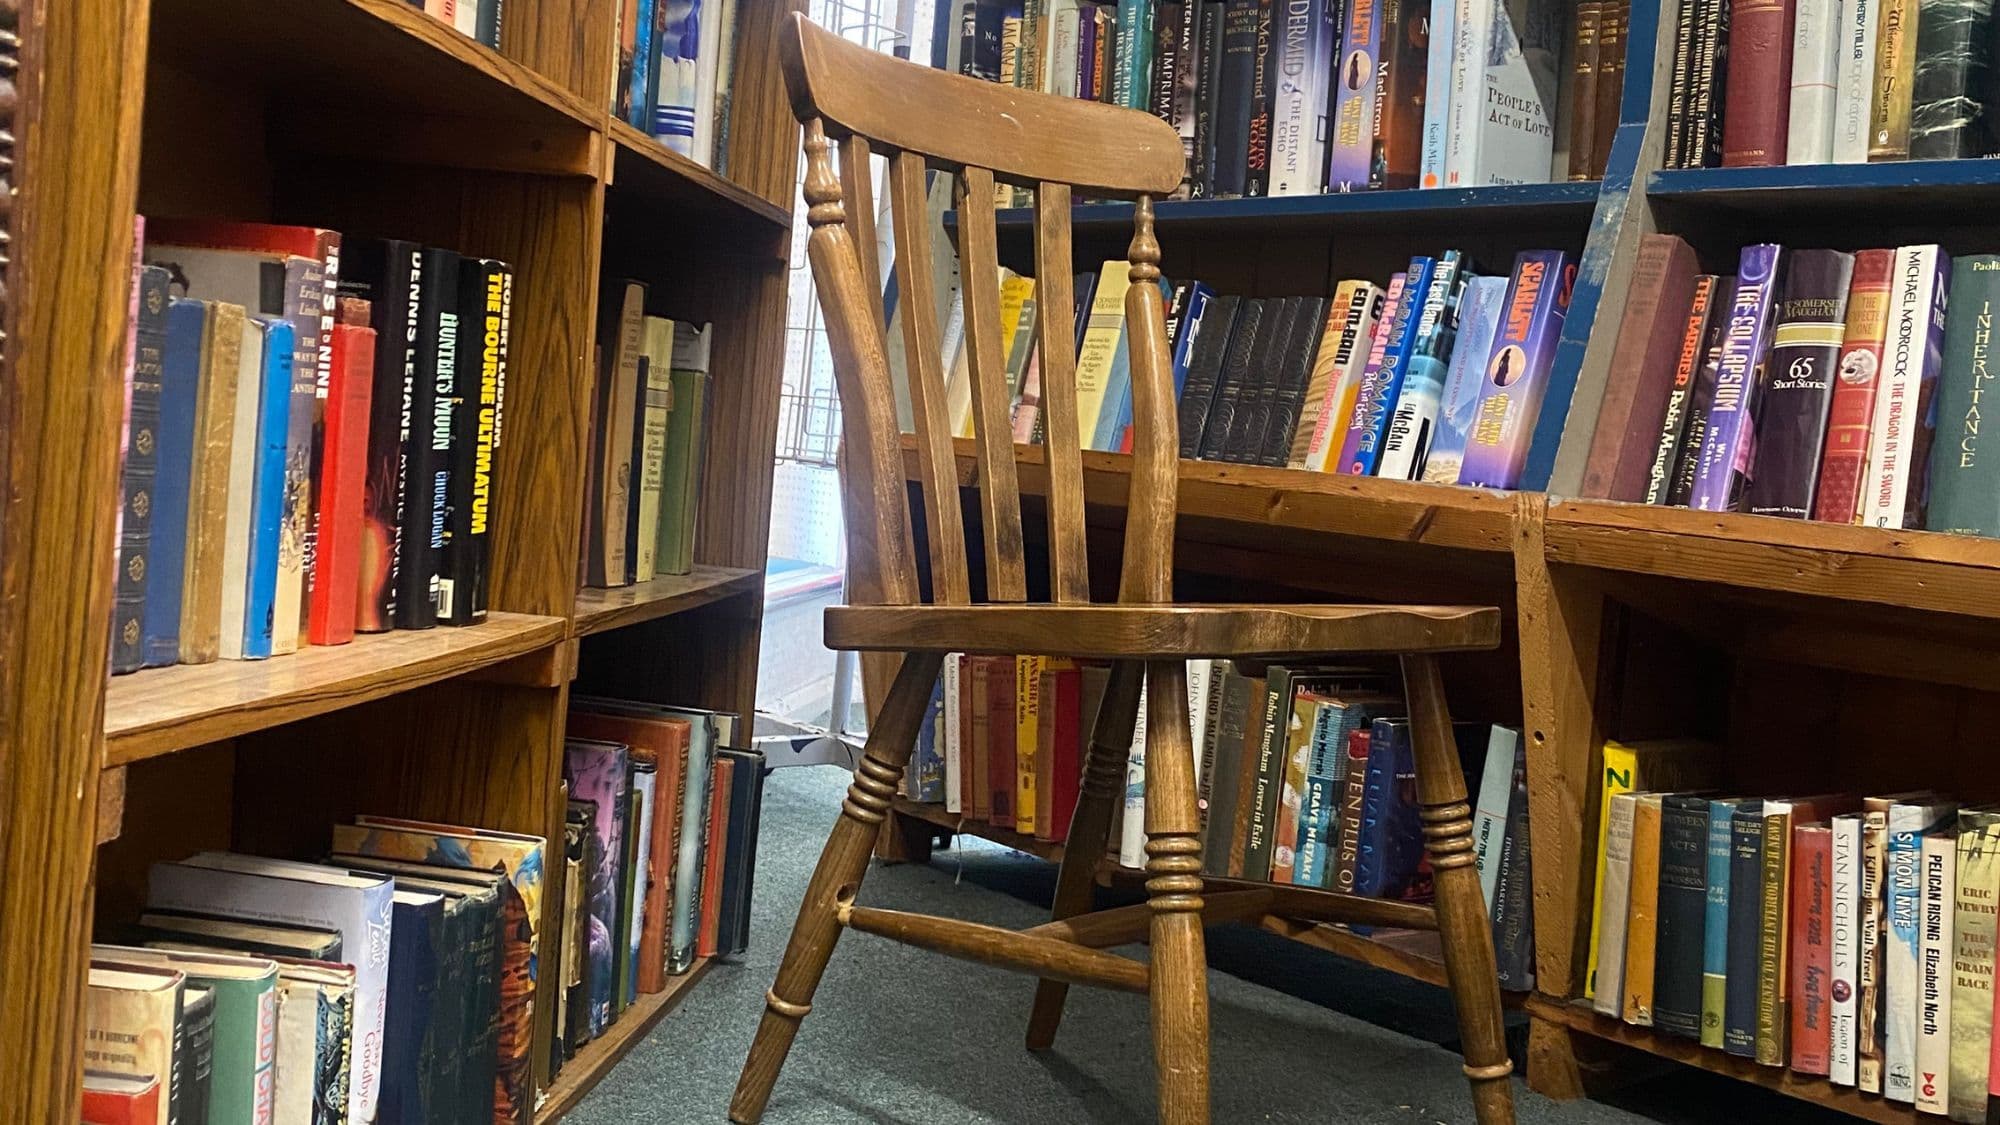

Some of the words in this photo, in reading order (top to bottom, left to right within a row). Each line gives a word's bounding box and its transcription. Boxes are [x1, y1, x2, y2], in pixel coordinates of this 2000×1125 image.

[1127, 5, 1137, 26] THE
[1856, 0, 1867, 27] HENRY
[1115, 32, 1125, 58] IRIS
[1122, 28, 1135, 72] MESSAGE
[1182, 27, 1191, 51] MAY
[1700, 23, 1718, 91] MARLBOROUGH
[1853, 28, 1864, 60] MILLER
[1883, 9, 1901, 70] Whispering
[1255, 19, 1271, 99] McDermid
[1486, 74, 1498, 83] THE
[1673, 27, 1691, 94] MARLBOROUGH
[1122, 74, 1132, 88] TO
[1160, 52, 1175, 123] IMPRIMA
[1373, 60, 1390, 137] Maelstrom
[1880, 76, 1896, 123] Swarm
[1291, 99, 1302, 120] THE
[1455, 103, 1463, 129] James
[1488, 87, 1541, 116] PEOPLE'S
[1671, 95, 1683, 114] HMS
[1697, 92, 1709, 112] HMS
[1257, 112, 1269, 170] SKELETON
[1277, 121, 1287, 152] ECHO
[1427, 122, 1439, 147] Keith
[1488, 109, 1511, 126] ACT
[1512, 119, 1523, 129] OF
[1526, 118, 1551, 138] LOVE
[1691, 118, 1707, 166] Monsarrat
[1248, 118, 1259, 169] ROAD
[1287, 125, 1299, 173] DISTANT
[1666, 121, 1681, 167] Monsarrat
[1387, 278, 1405, 298] ED
[1407, 263, 1424, 285] ED
[1433, 261, 1456, 281] The
[1902, 250, 1922, 307] MICHAEL
[320, 256, 340, 331] RISE
[406, 252, 421, 342] DENNIS
[486, 273, 503, 313] THE
[1353, 287, 1369, 306] ED
[1426, 279, 1446, 306] Last
[1504, 261, 1545, 342] SCARLETT
[1691, 276, 1713, 314] THE
[1735, 282, 1765, 313] THE
[499, 274, 512, 358] ROBERT
[1334, 306, 1362, 365] McBAIN
[1368, 299, 1397, 366] McBAIN
[1389, 288, 1418, 348] McBAIN
[1418, 303, 1442, 337] Dance
[435, 312, 459, 393] HUNTER'S
[480, 316, 501, 405] BOURNE
[1674, 315, 1701, 387] BARRIER
[1712, 312, 1756, 413] COLLAPSIUM
[1893, 308, 1916, 378] MOORCOCK
[316, 346, 333, 399] NINE
[1773, 379, 1796, 389] Short
[1796, 378, 1828, 390] Stories
[1789, 357, 1815, 379] 65
[1960, 300, 1995, 468] INHERITANCE
[400, 349, 415, 441] LEHANE
[492, 361, 506, 449] LUDLUM
[1359, 355, 1398, 453] ROMANCE
[1403, 402, 1417, 413] Ed
[1892, 383, 1905, 400] THE
[431, 397, 453, 450] MOON
[1387, 410, 1411, 452] McBAIN
[1662, 390, 1686, 433] Robin
[1888, 400, 1903, 440] DRAGON
[1700, 426, 1720, 480] McCARTHY
[1713, 443, 1727, 464] WIL
[1883, 453, 1897, 472] THE
[1887, 440, 1899, 453] IN
[396, 454, 407, 520] MYSTIC
[471, 408, 495, 535] ULTIMATUM
[1646, 434, 1675, 505] Maugham
[433, 471, 447, 509] CHUCK
[1878, 471, 1895, 508] SWORD
[430, 509, 445, 549] LOGAN
[302, 532, 313, 573] LORE
[392, 526, 403, 579] RIVER
[1190, 672, 1200, 703] JOHN
[1207, 665, 1223, 716] BERNARD
[1267, 690, 1280, 717] Robin
[1203, 718, 1217, 769] MALAMUD
[1318, 708, 1332, 740] Ngaio
[1258, 719, 1273, 773] Maugham
[1315, 741, 1328, 775] Marsh
[1255, 776, 1269, 808] Lovers
[1347, 769, 1365, 803] TEN
[1606, 767, 1630, 788] N
[1253, 809, 1263, 819] in
[1308, 782, 1322, 825] GRAVE
[1250, 820, 1263, 850] Exile
[1341, 806, 1362, 863] PLUS
[1481, 817, 1492, 844] HENRY
[1669, 841, 1698, 852] ACTS
[1301, 826, 1317, 881] MISTAKE
[1476, 843, 1487, 872] MILLER
[1502, 836, 1512, 876] EDWARD
[1835, 833, 1850, 875] STAN
[1896, 832, 1914, 890] SIMON
[1864, 855, 1877, 898] Killing
[1927, 854, 1942, 901] PELICAN
[1962, 887, 1992, 899] ERIC
[1496, 877, 1508, 923] MARSTON
[1764, 882, 1778, 932] INTERIOR
[1864, 901, 1873, 916] on
[1894, 895, 1912, 929] NYE
[1956, 902, 1998, 914] NEWBY
[1834, 881, 1849, 969] NICHOLLS
[1863, 919, 1875, 946] Wall
[1926, 903, 1941, 942] RISING
[1962, 932, 1988, 943] THE
[367, 920, 381, 974] Lewis
[1764, 935, 1776, 958] THE
[1863, 947, 1874, 982] Street
[1960, 946, 1988, 958] LAST
[1763, 960, 1775, 974] TO
[1924, 948, 1940, 1002] Elizabeth
[1955, 961, 1993, 975] GRAIN
[1957, 977, 1989, 990] RACE
[1763, 975, 1775, 1025] JOURNEY
[1924, 1002, 1938, 1036] North
[259, 992, 274, 1062] COLD
[1763, 1025, 1773, 1034] A
[1838, 1014, 1853, 1048] Legion
[359, 1031, 375, 1109] Goodbye
[1838, 1052, 1848, 1067] of
[1890, 1076, 1912, 1089] VIKING
